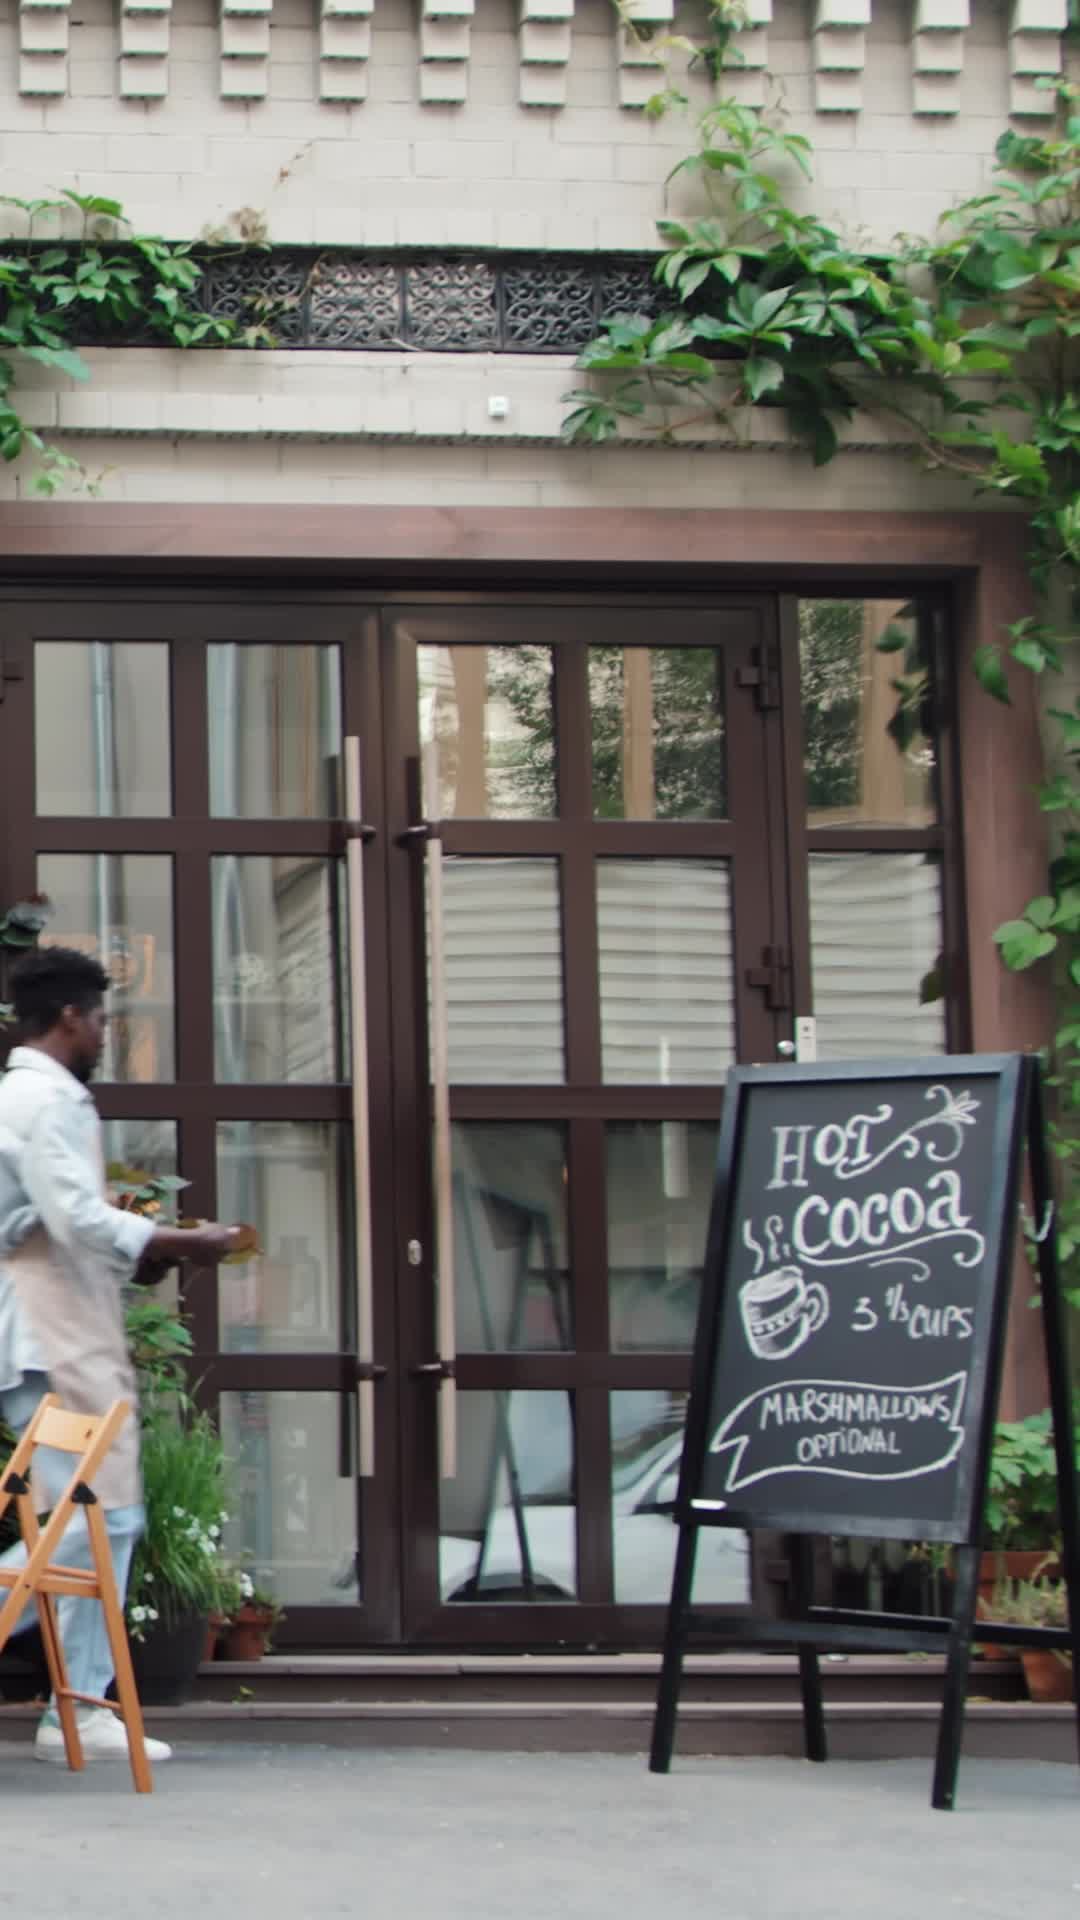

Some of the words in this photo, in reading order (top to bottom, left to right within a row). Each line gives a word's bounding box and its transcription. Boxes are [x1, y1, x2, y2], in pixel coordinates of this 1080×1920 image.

[765, 1104, 893, 1189] HOT
[851, 1296, 878, 1331] 3
[908, 1304, 974, 1339] CUPS
[759, 1388, 951, 1431] MARSHMALLOWS
